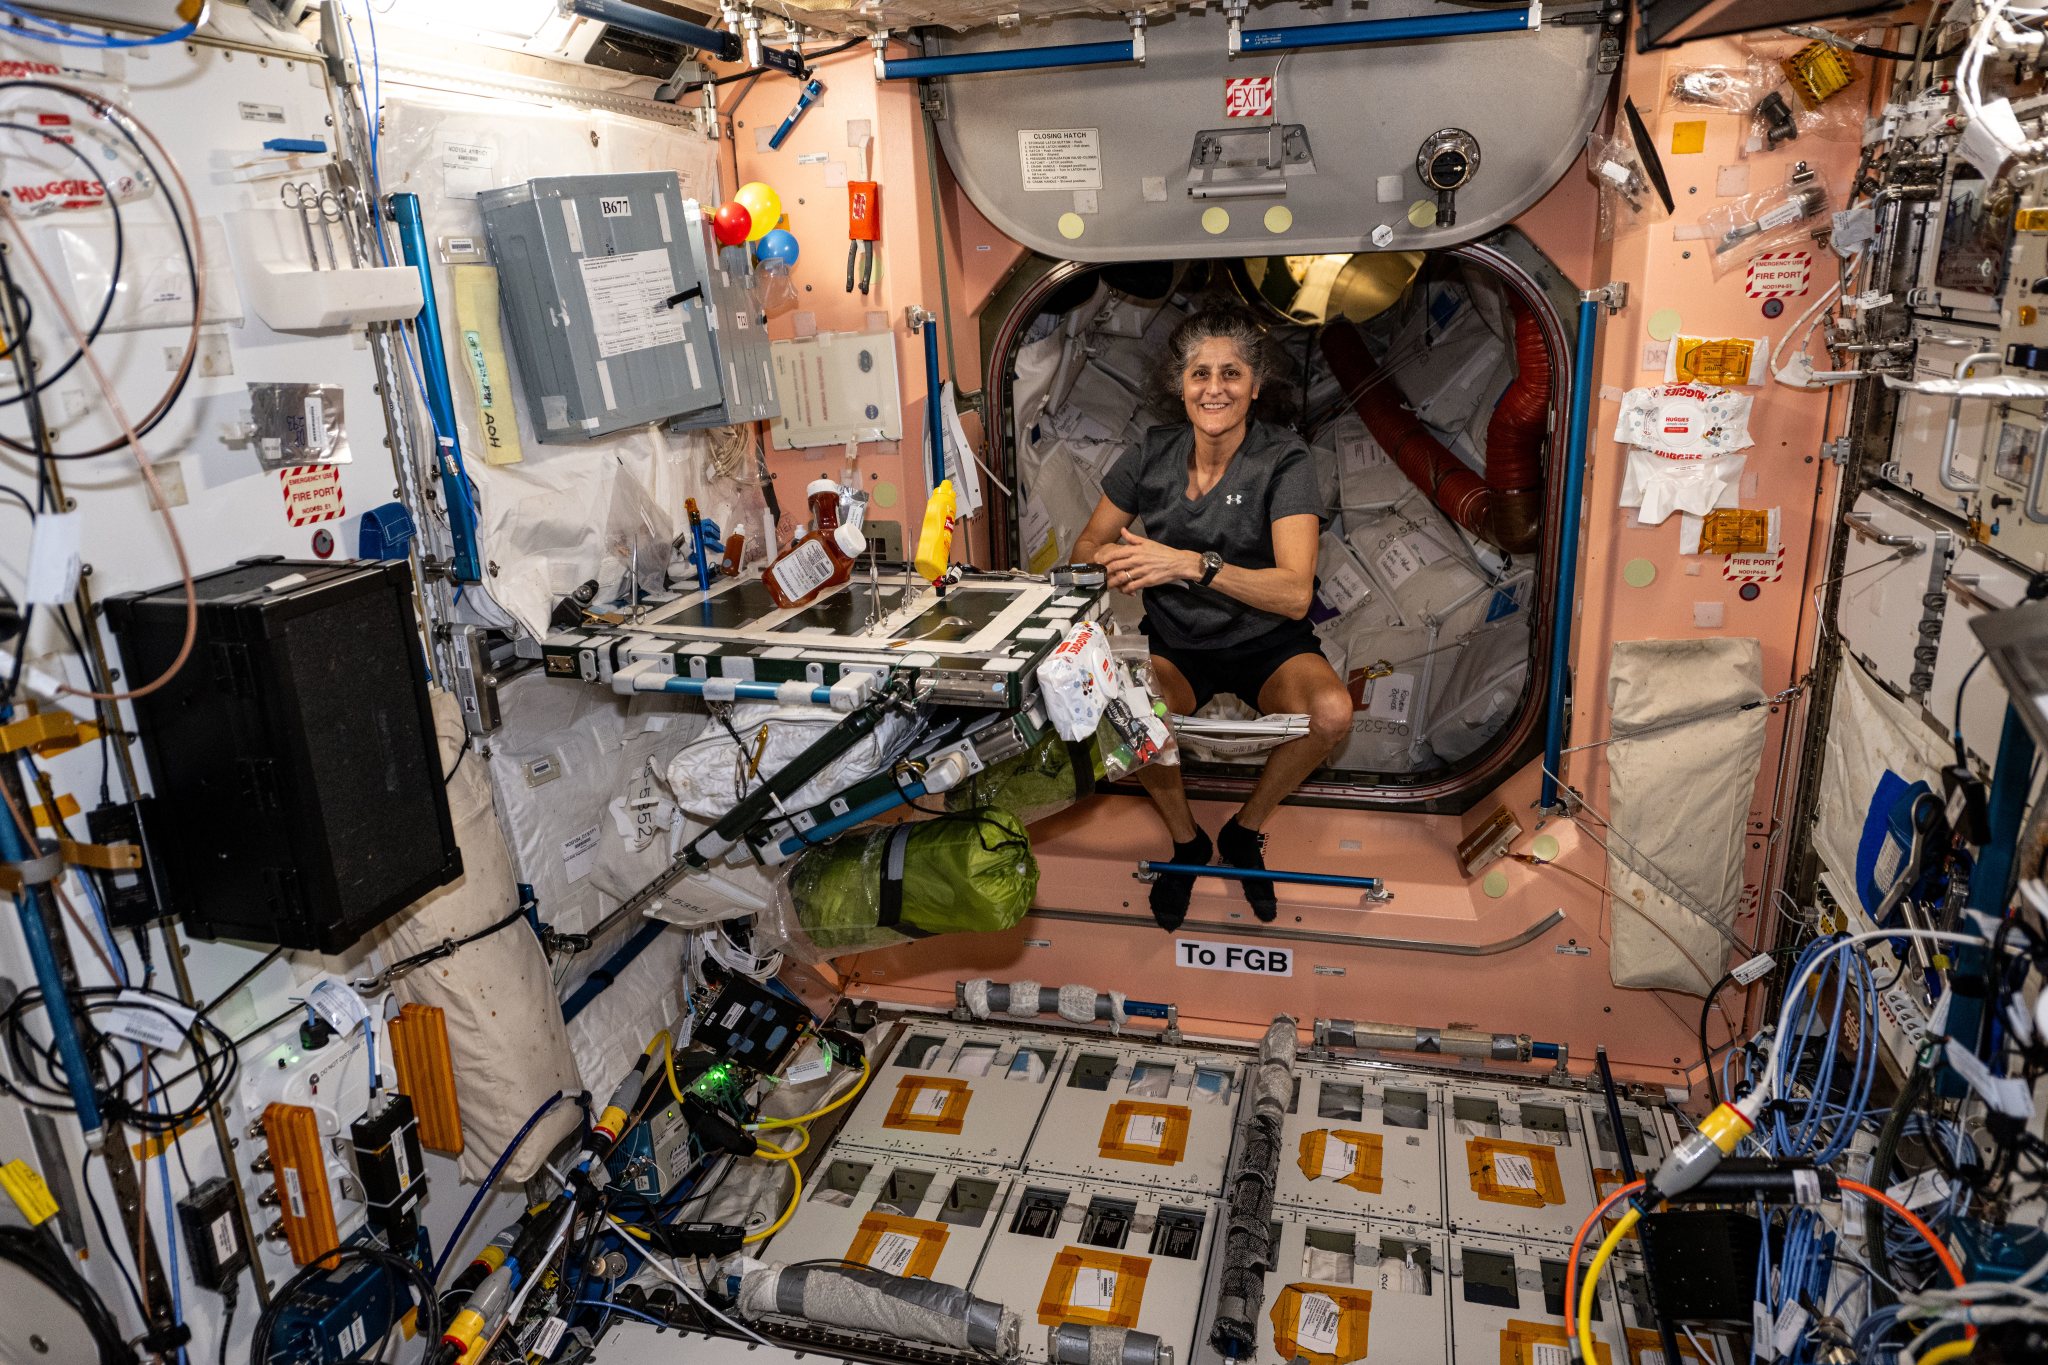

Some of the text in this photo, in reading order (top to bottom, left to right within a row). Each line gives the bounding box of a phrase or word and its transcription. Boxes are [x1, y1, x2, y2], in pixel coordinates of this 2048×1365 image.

[1233, 87, 1264, 107] EXIT
[13, 180, 104, 203] HUGGIES
[602, 201, 628, 214] B677
[1664, 387, 1708, 402] HUGGIES
[289, 475, 321, 485] EMERGENCY
[293, 487, 335, 502] FIRE PORT
[1068, 632, 1092, 655] HUGGIES
[1181, 943, 1289, 972] To FGB
[320, 1068, 328, 1076] DO
[329, 1059, 338, 1069] NOT
